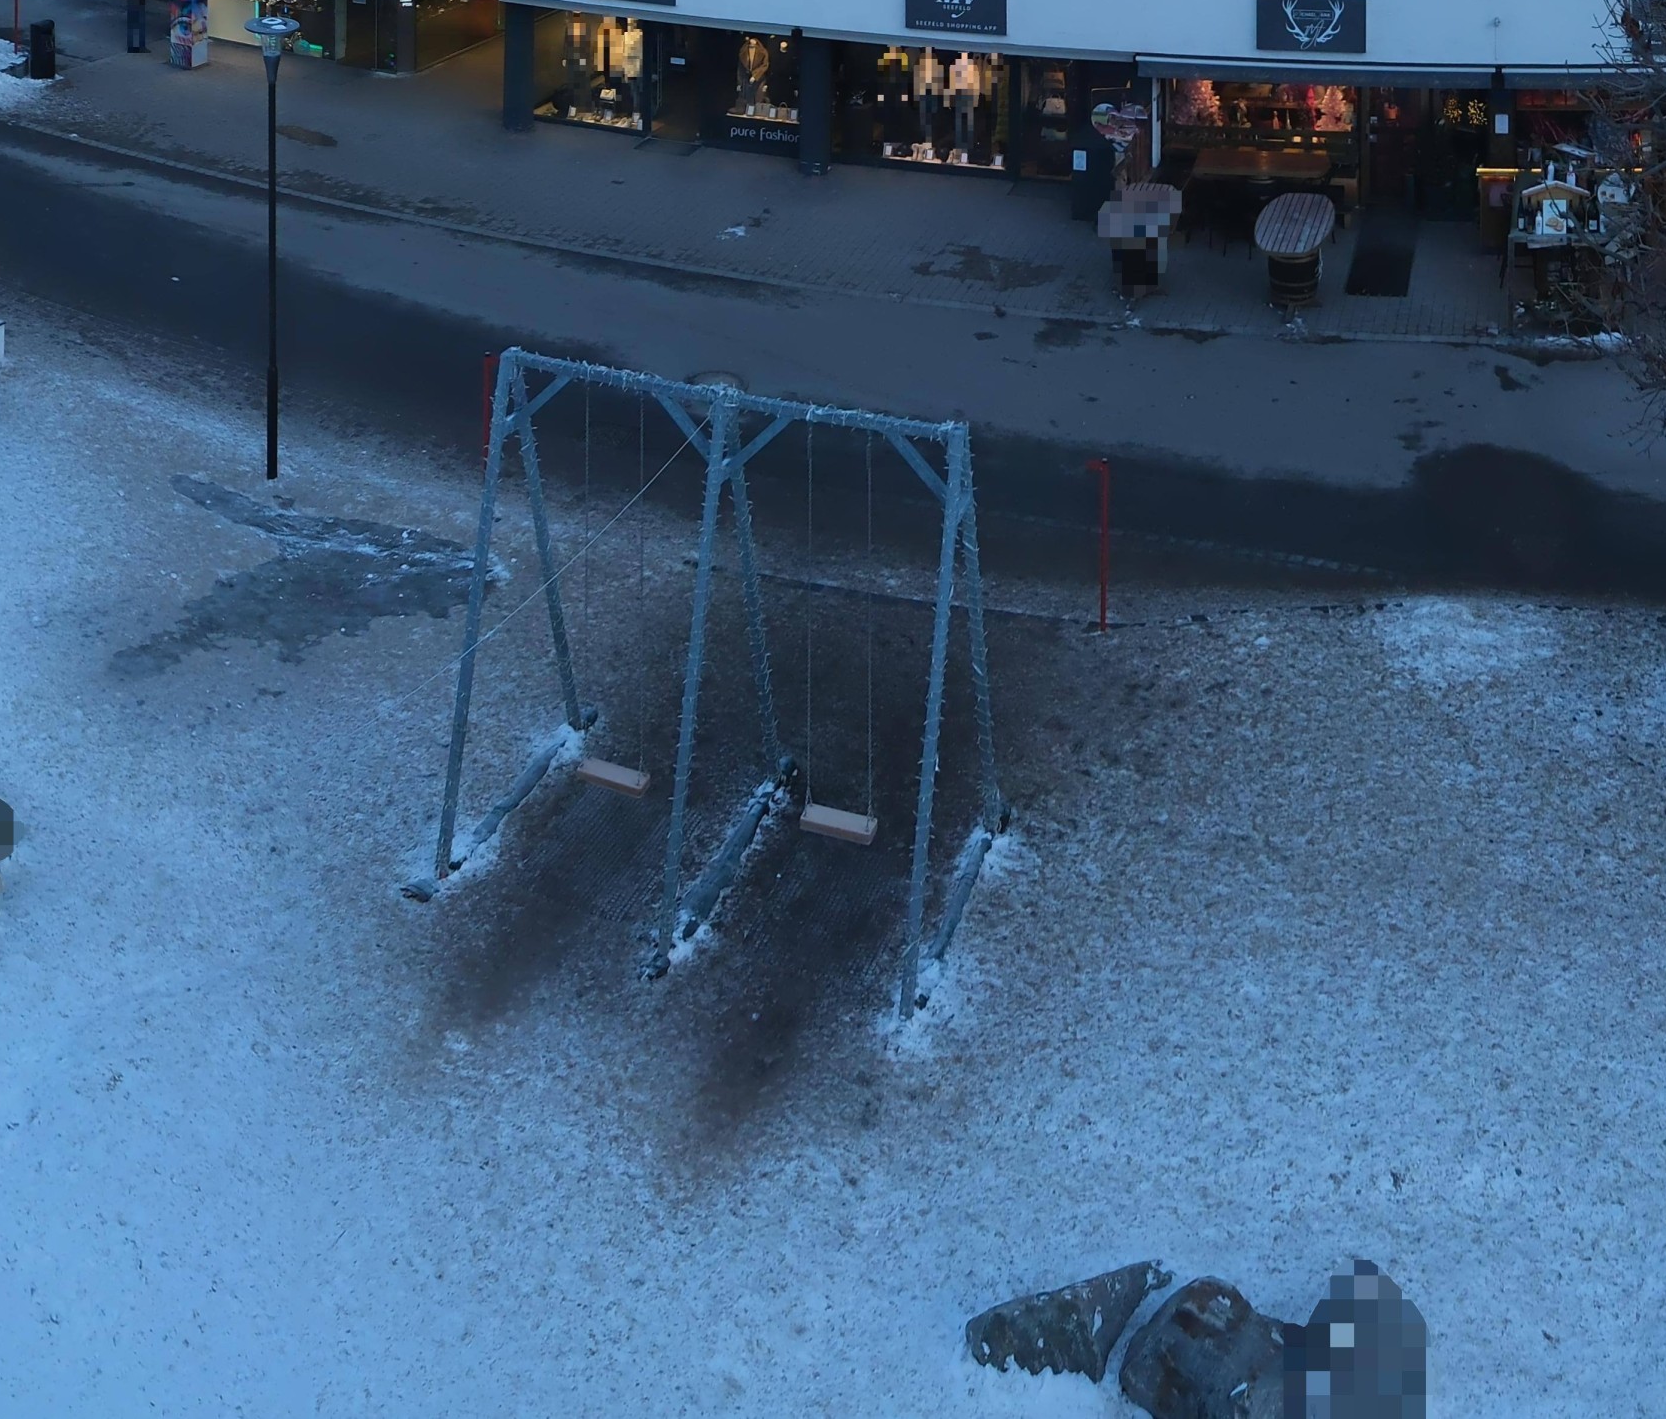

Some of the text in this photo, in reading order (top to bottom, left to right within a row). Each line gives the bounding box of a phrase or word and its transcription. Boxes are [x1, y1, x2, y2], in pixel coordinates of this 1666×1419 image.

[942, 4, 971, 13] SEEFELD
[915, 19, 944, 28] SEEFELD
[946, 22, 981, 31] SHOPPING
[730, 126, 756, 138] pure
